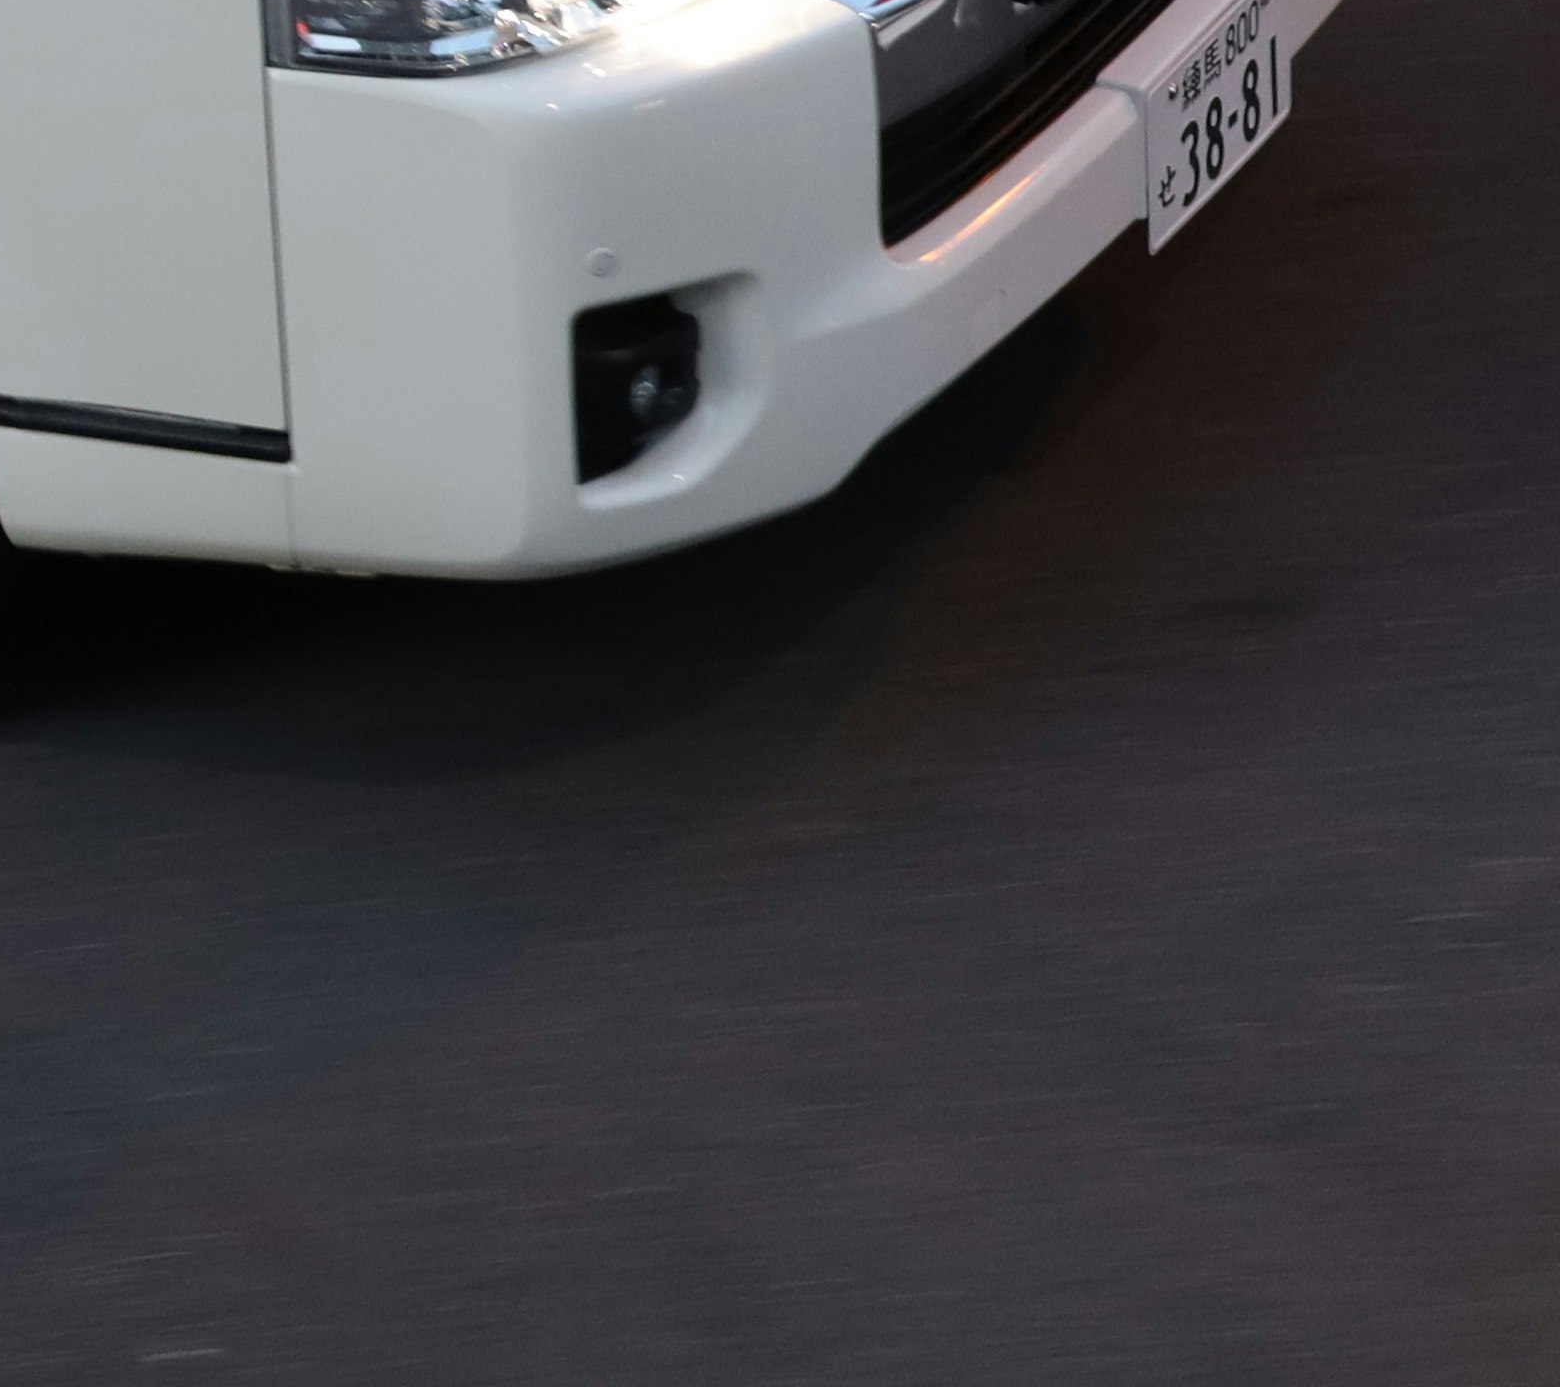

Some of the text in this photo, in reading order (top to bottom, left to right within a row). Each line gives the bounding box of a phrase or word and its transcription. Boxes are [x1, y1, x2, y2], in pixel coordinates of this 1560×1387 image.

[1225, 0, 1260, 66] 800
[1158, 35, 1278, 208] せ 38-81
